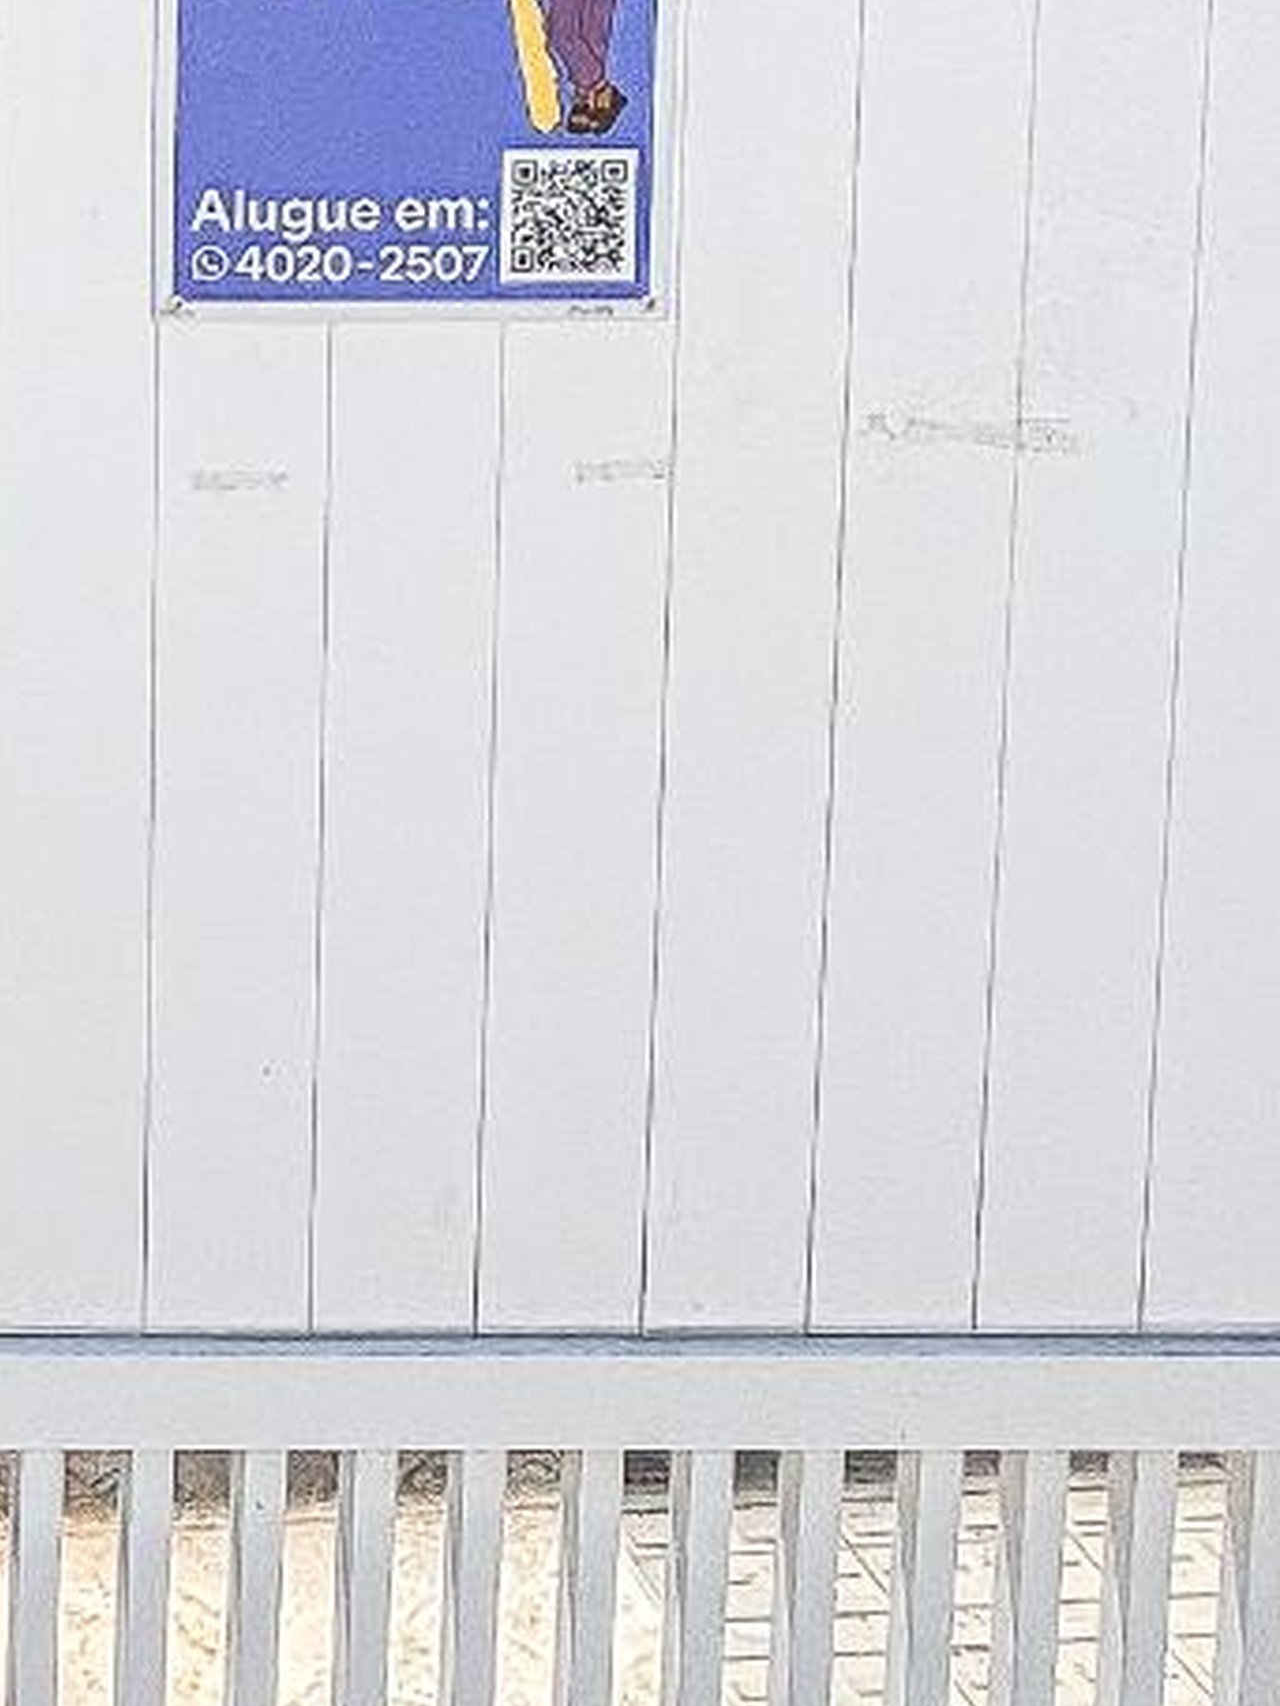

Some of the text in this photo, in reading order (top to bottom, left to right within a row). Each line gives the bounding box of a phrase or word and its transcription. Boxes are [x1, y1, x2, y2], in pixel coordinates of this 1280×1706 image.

[192, 189, 491, 240] Alugue em:
[235, 243, 490, 282] 4020-2507
